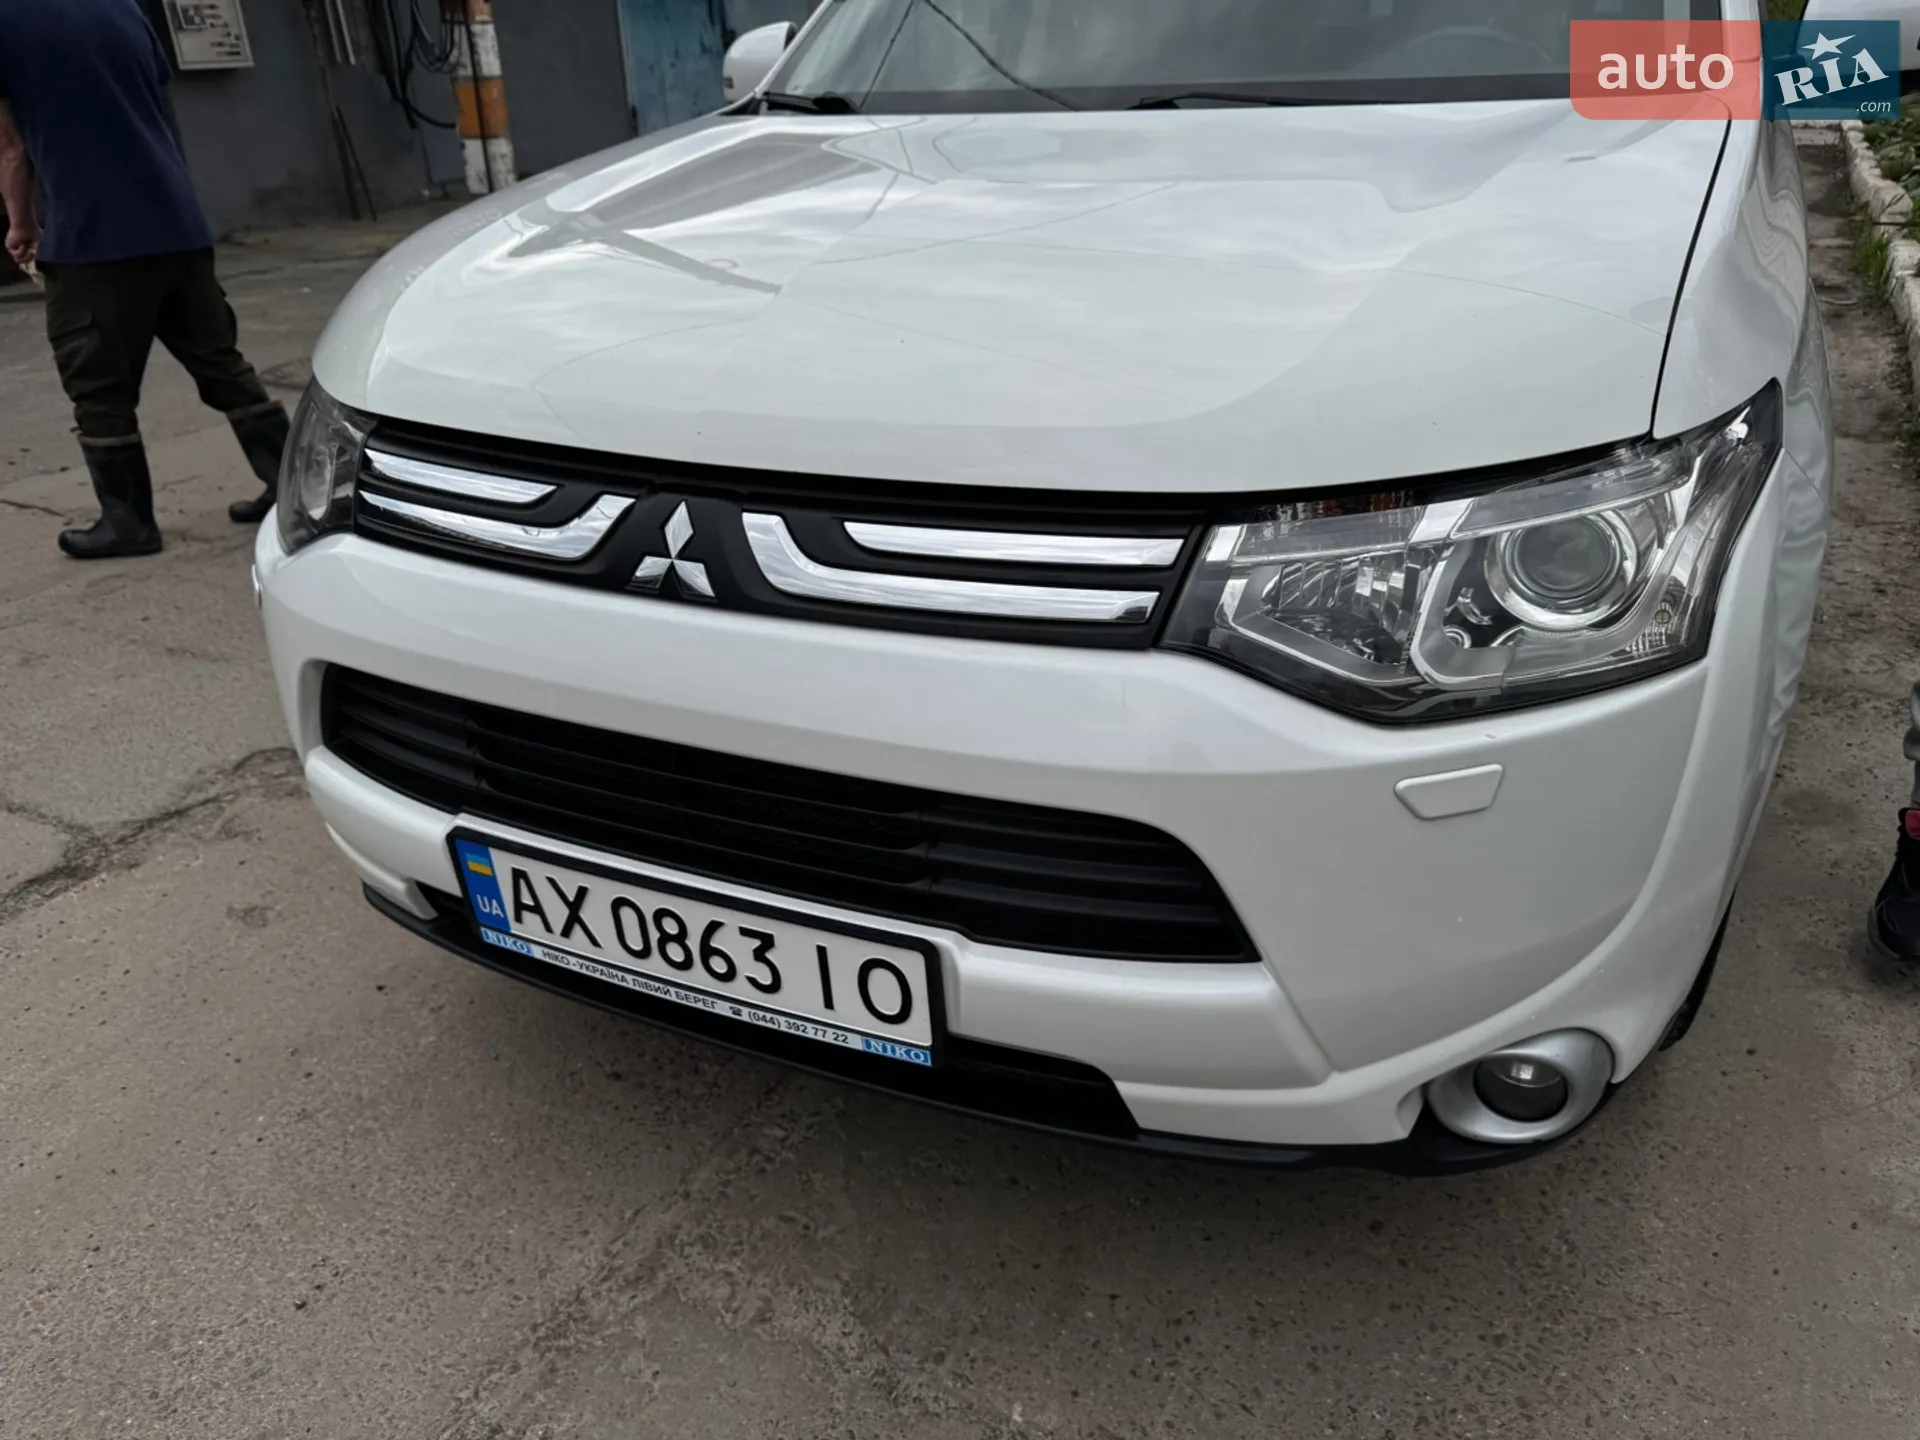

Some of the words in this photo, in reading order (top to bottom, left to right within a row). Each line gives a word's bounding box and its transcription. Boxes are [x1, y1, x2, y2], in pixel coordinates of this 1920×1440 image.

[476, 894, 505, 919] UA
[487, 930, 529, 954] NIKO
[510, 865, 603, 949] AX
[610, 895, 783, 995] 0863
[675, 990, 718, 1011] БЕРЕГ
[747, 1009, 782, 1031] (044)
[784, 1019, 809, 1036] 392
[811, 1025, 828, 1040] 77
[831, 1031, 849, 1045] 22
[870, 1039, 925, 1063] NIKO
